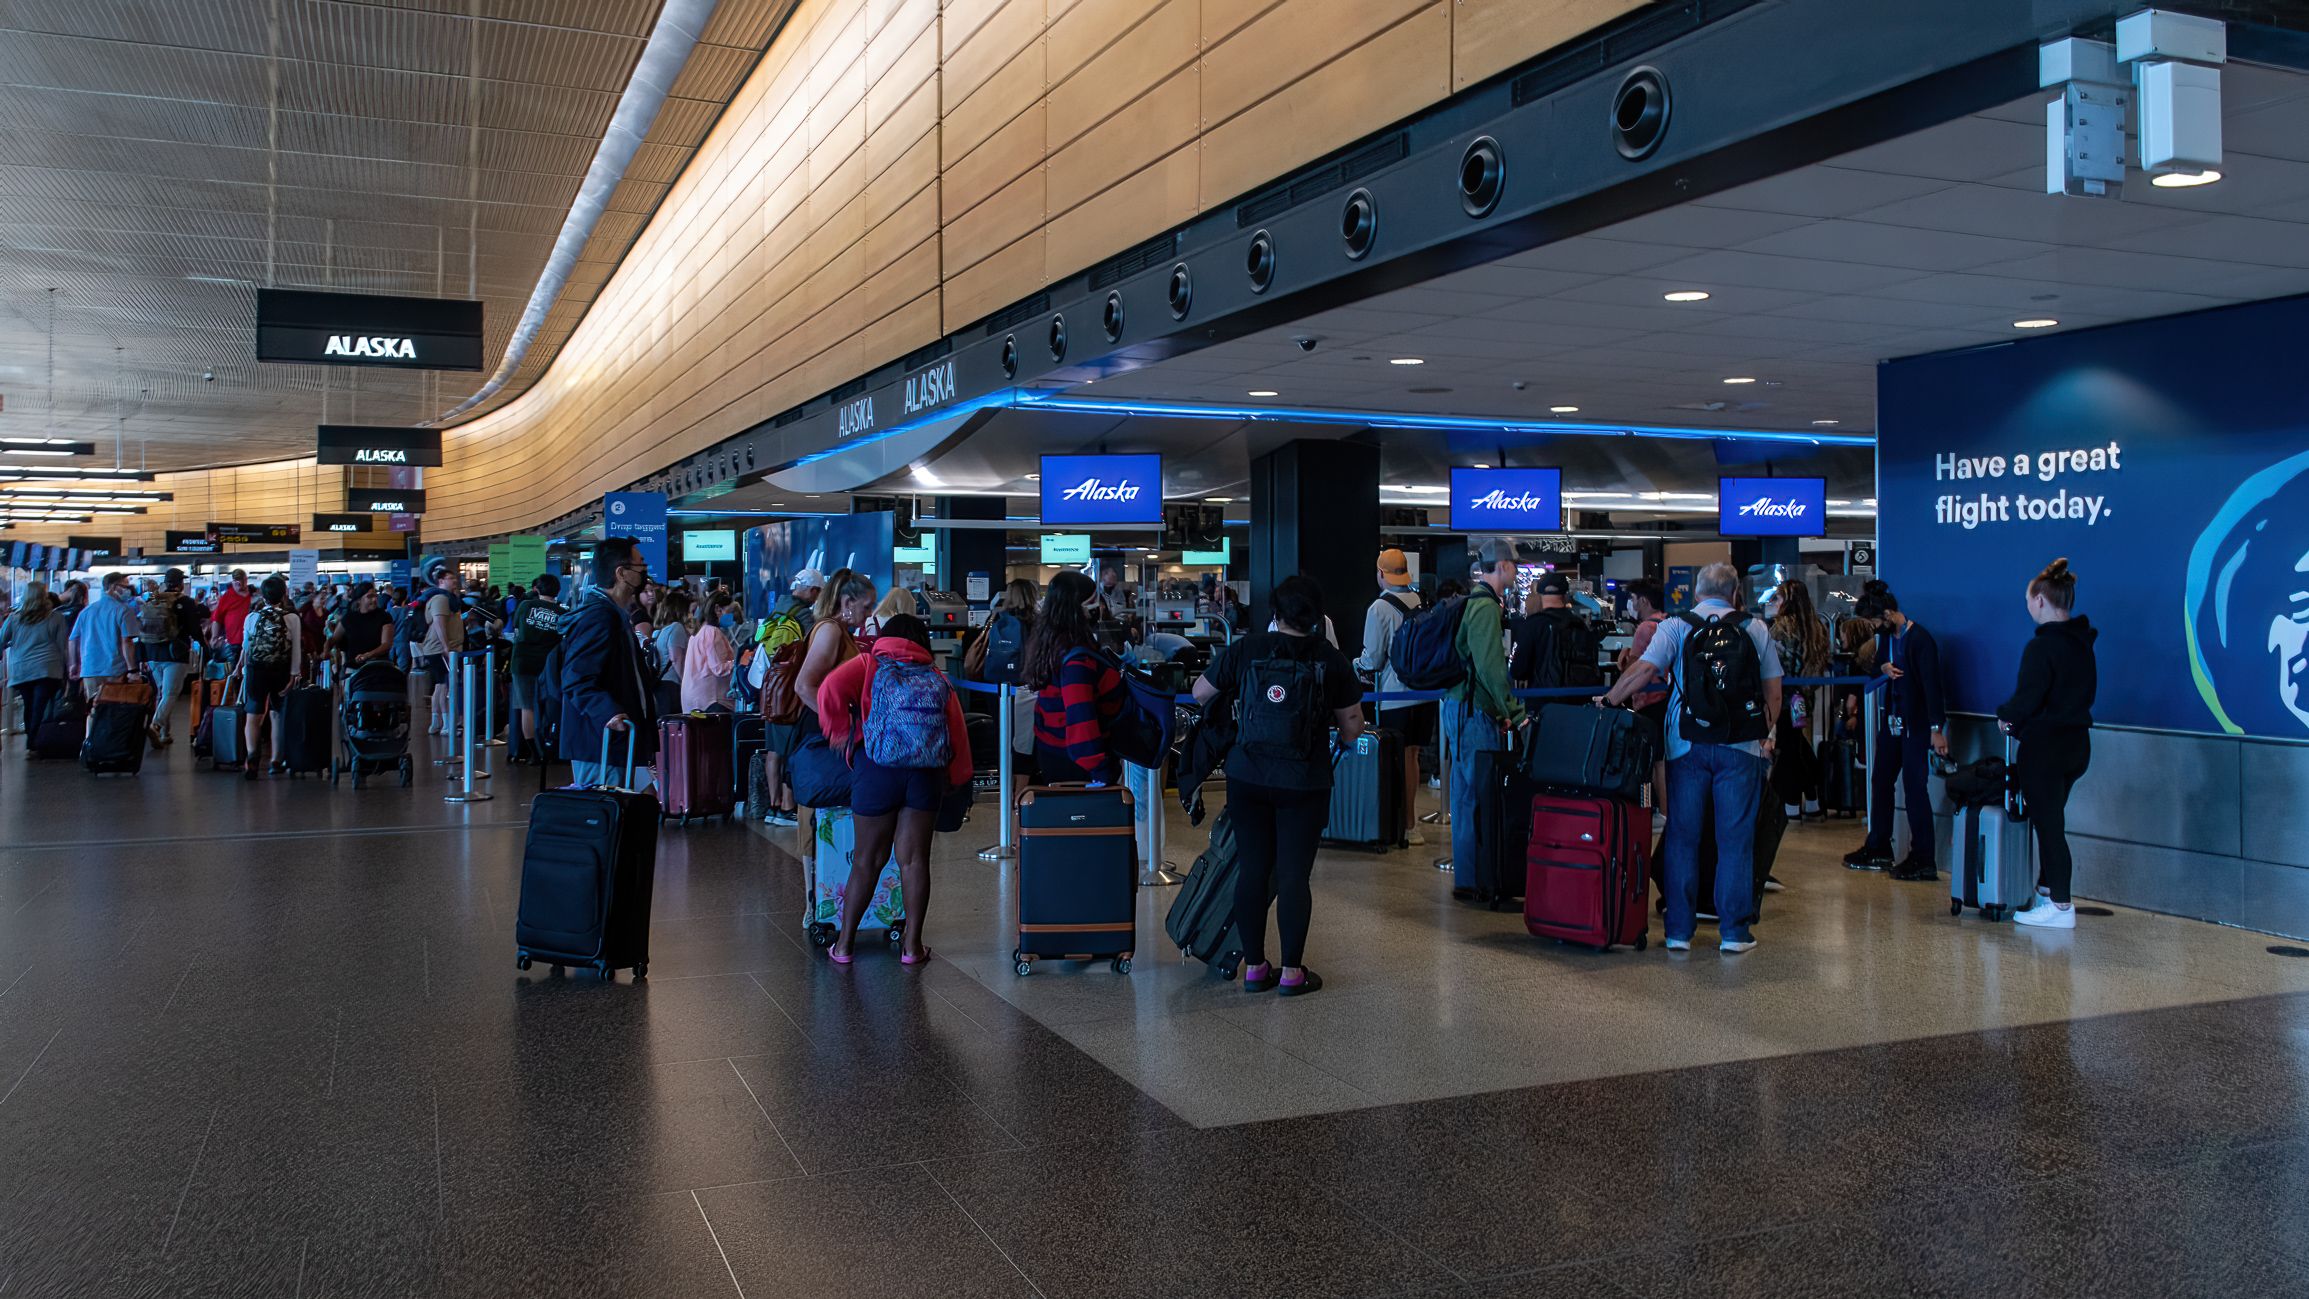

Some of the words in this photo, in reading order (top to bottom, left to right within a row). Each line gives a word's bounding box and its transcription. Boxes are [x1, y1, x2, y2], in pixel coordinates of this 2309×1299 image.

[325, 335, 417, 359] ALASKA
[903, 362, 955, 415] ALASKA
[839, 396, 874, 438] ALASKA
[355, 449, 406, 463] ALASKA
[1936, 452, 2006, 480] Have
[2013, 454, 2030, 476] a
[2038, 441, 2121, 482] great
[1063, 478, 1140, 503] Alaska
[1471, 489, 1541, 512] Alaska
[370, 502, 404, 511] ALASKA
[1739, 497, 1807, 519] Alaska
[1935, 493, 2010, 530] flight
[2015, 489, 2112, 526] today.
